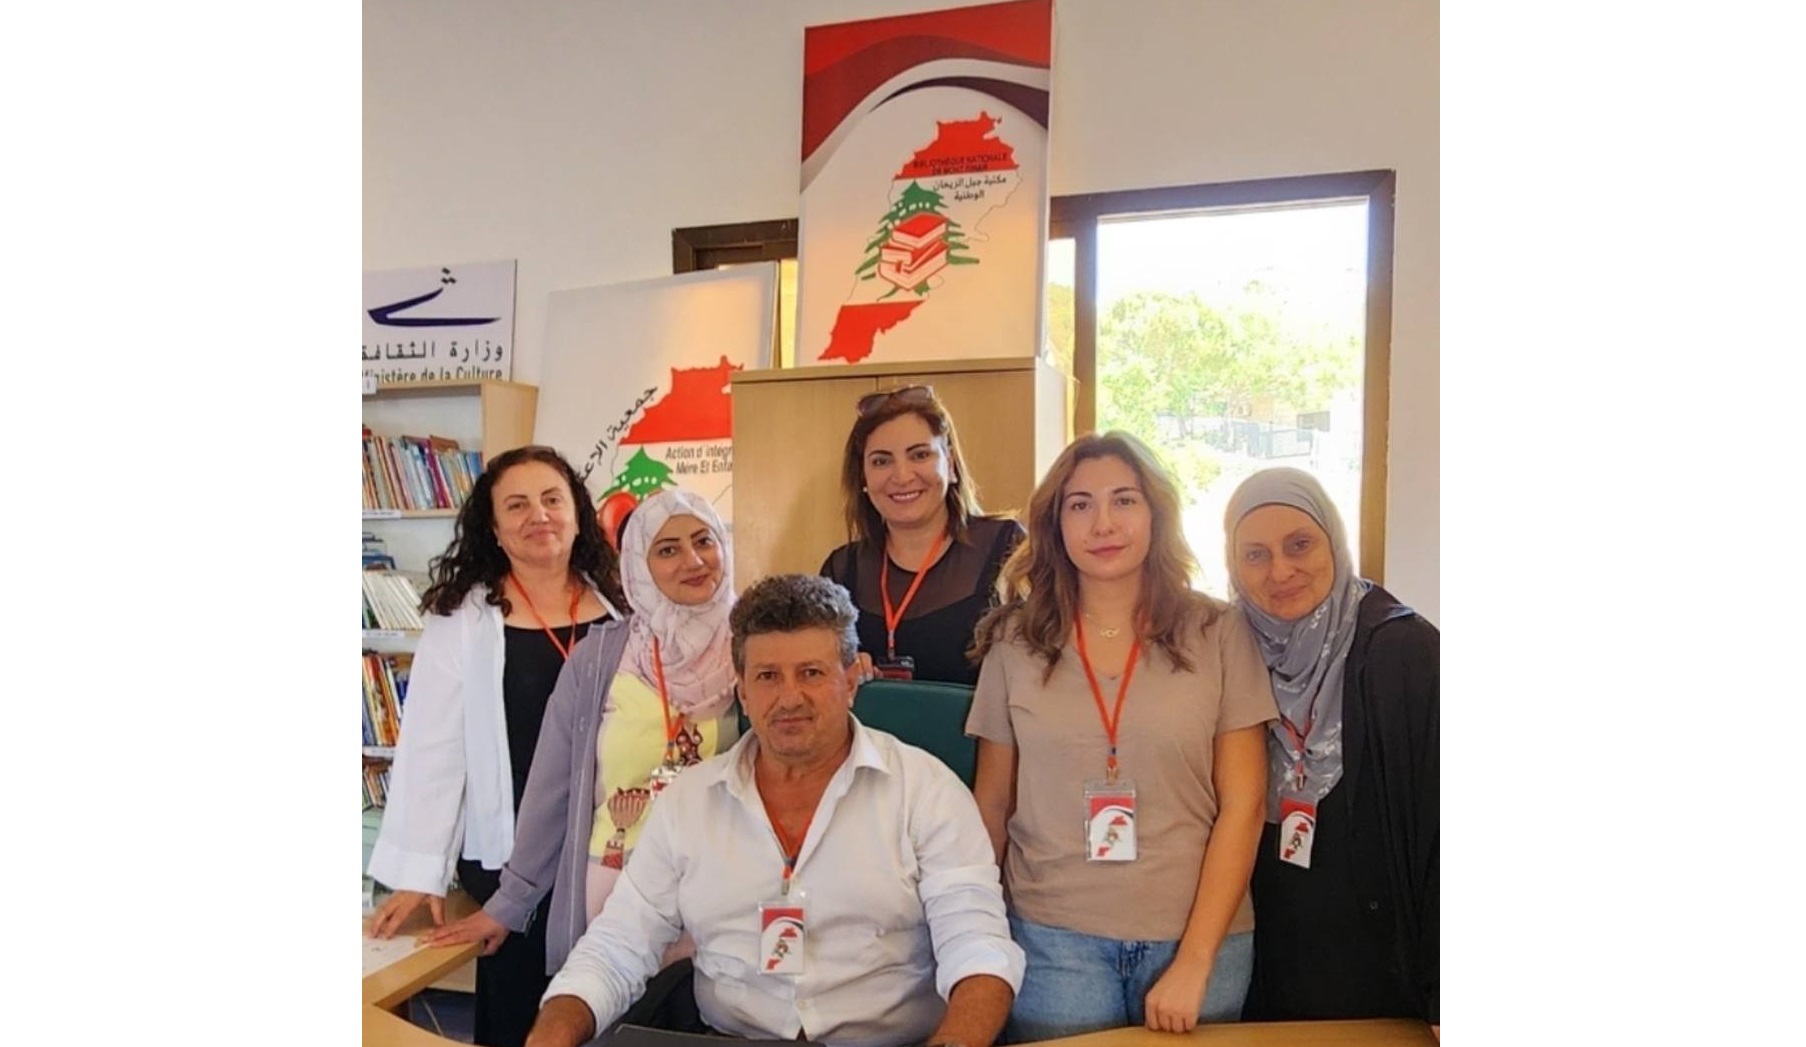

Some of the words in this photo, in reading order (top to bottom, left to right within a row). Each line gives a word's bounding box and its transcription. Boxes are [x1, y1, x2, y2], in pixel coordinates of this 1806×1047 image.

[932, 178, 964, 190] الريحان
[965, 177, 982, 188] جبل
[984, 175, 1007, 186] مكتبة
[954, 189, 985, 202] الوطنية
[450, 339, 503, 362] وزارة
[420, 367, 435, 380] de
[440, 366, 451, 380] la
[456, 364, 503, 380] Culture
[606, 386, 658, 441] جمعية
[665, 446, 694, 459] Action
